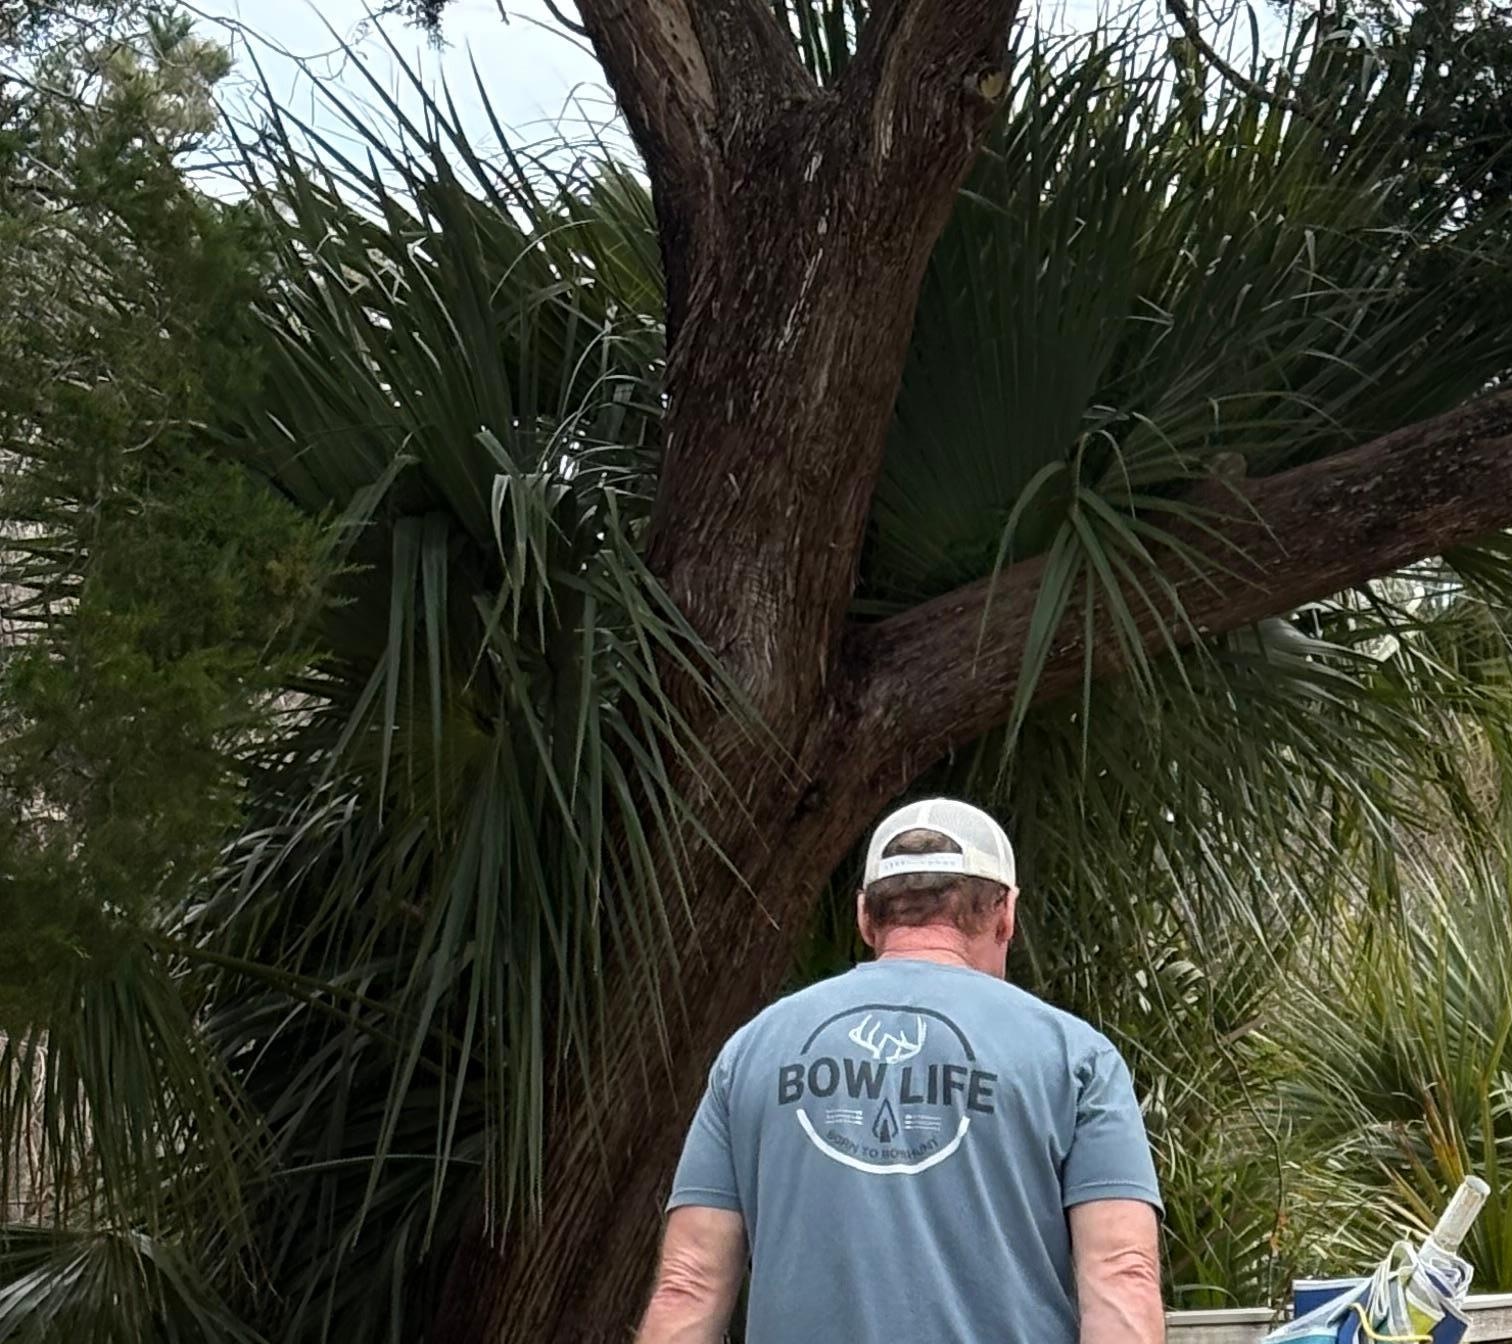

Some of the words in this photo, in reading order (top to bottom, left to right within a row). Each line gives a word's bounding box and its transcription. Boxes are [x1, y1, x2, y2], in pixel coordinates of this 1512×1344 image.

[778, 1056, 887, 1106] BOW
[900, 1063, 998, 1115] LIFE
[862, 1146, 879, 1158] TO
